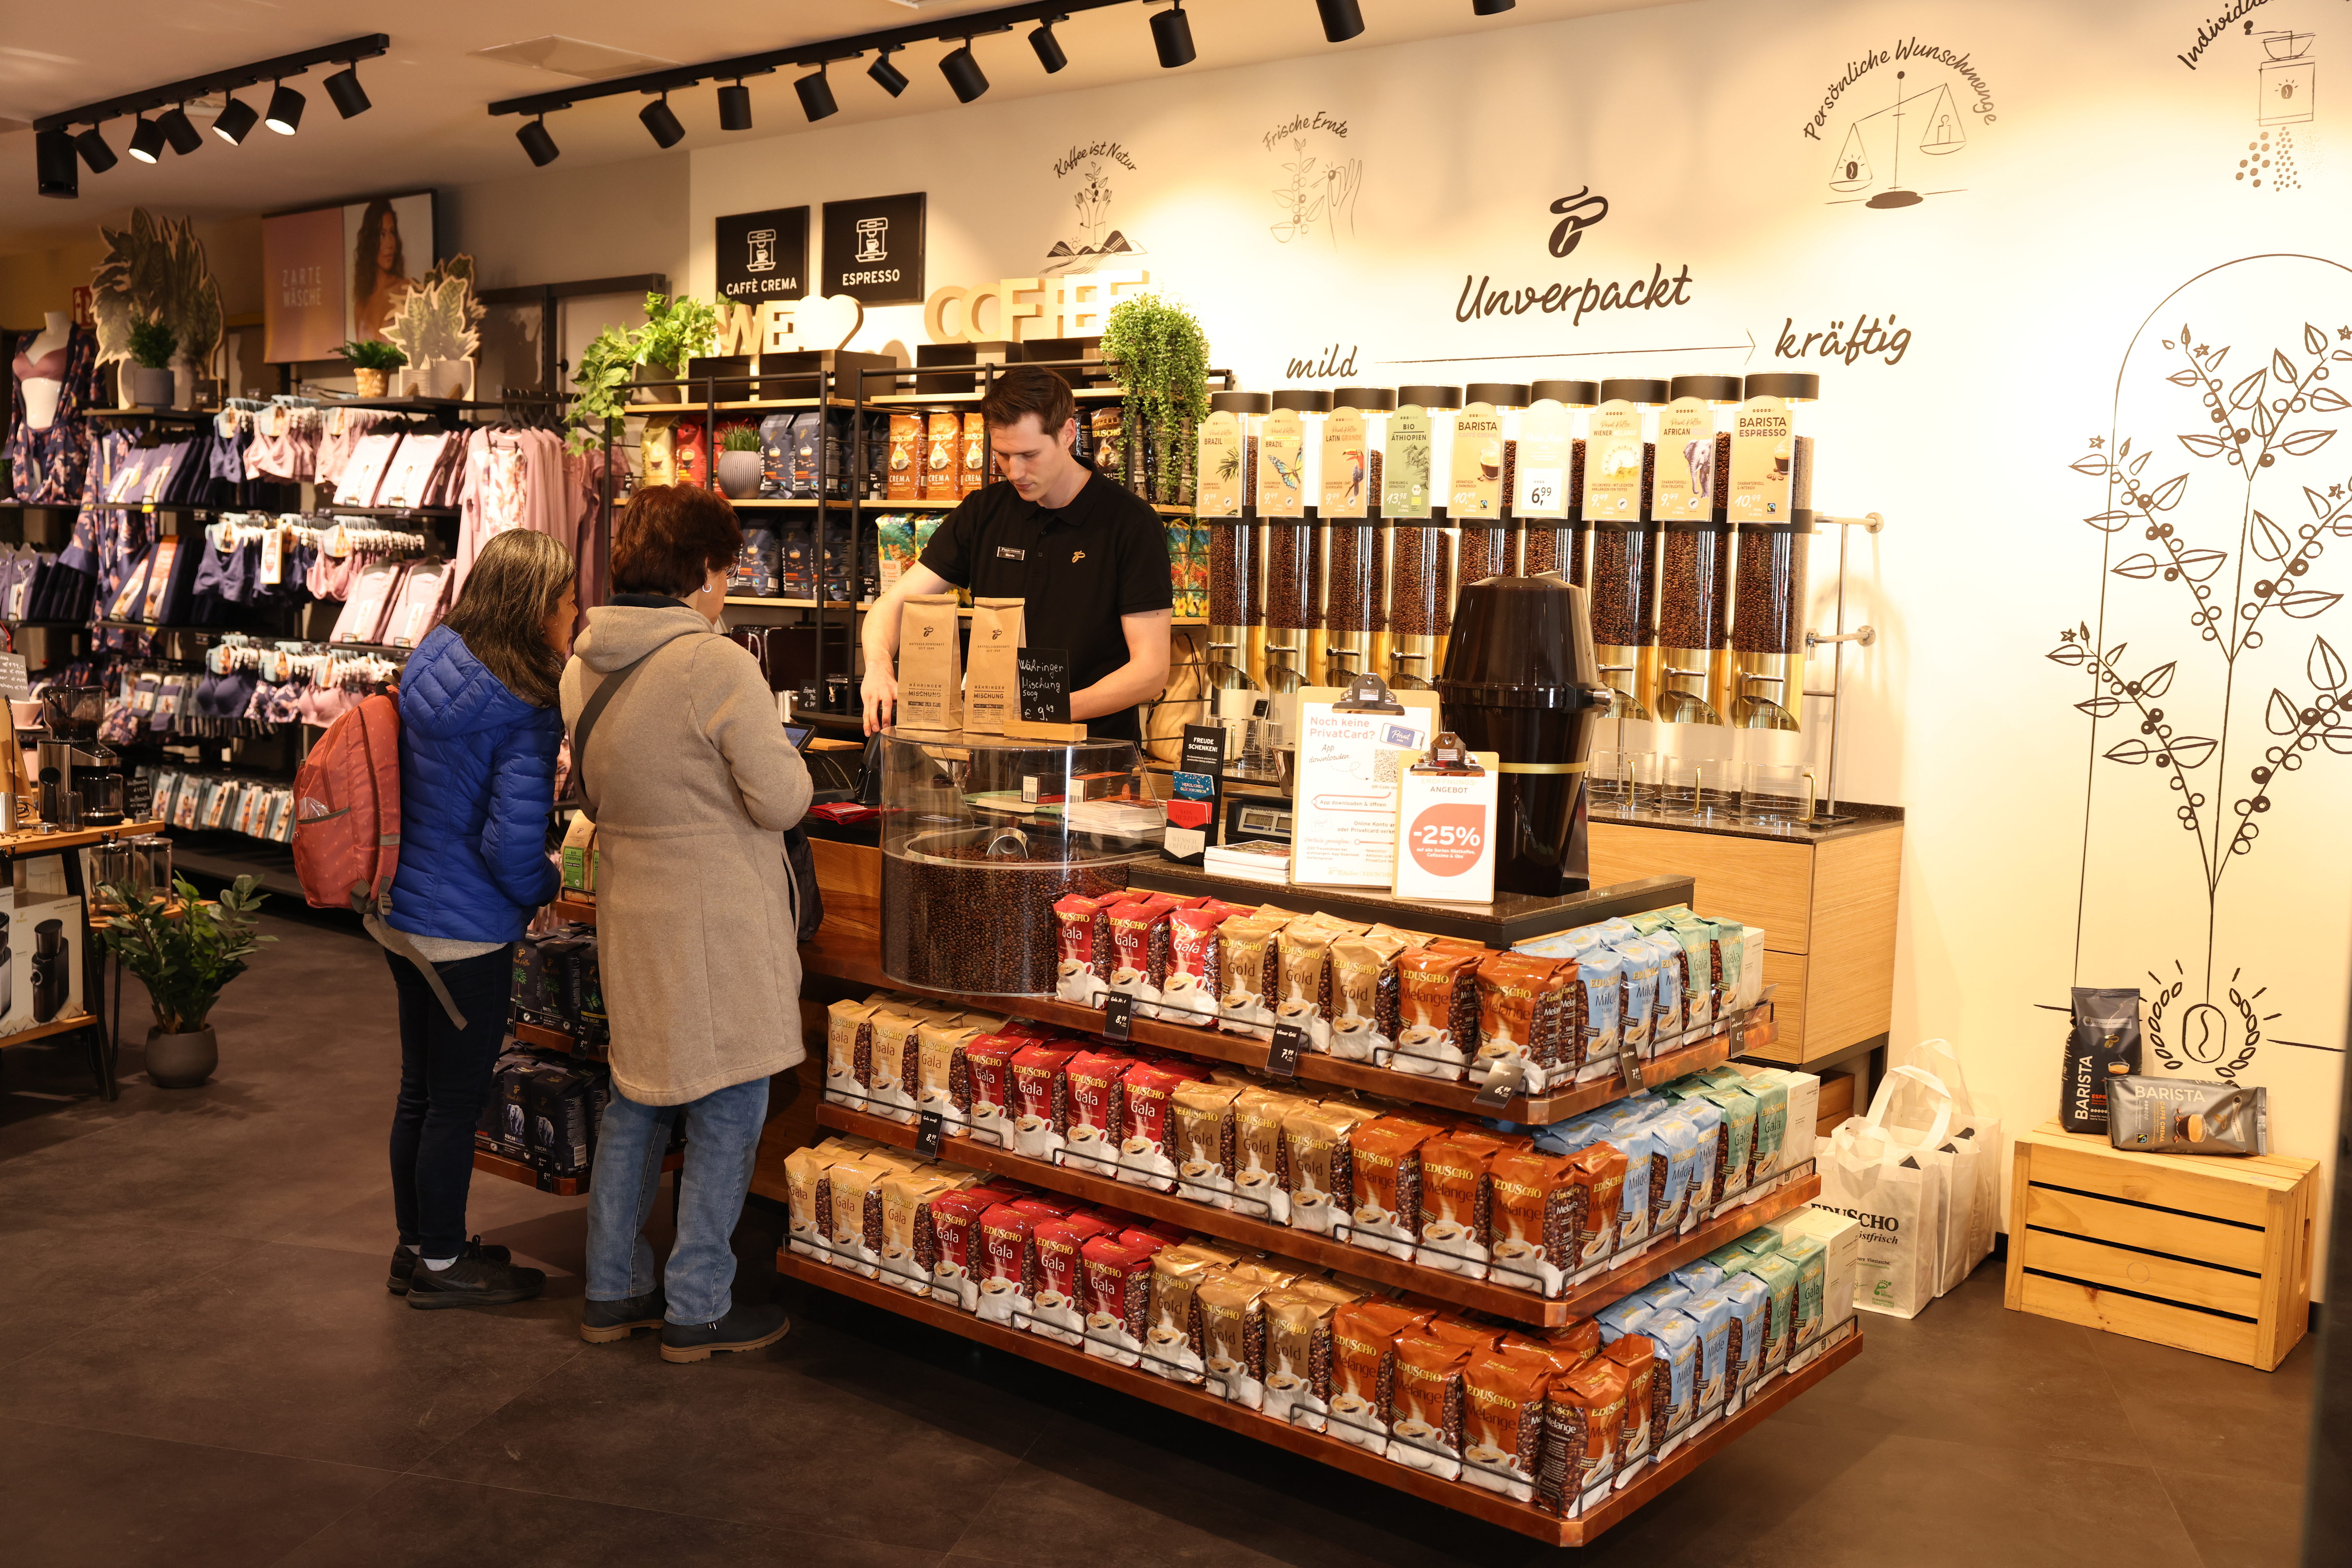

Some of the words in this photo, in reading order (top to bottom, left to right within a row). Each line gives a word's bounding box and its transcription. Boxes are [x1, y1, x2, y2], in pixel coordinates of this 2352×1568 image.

[1803, 49, 1890, 140] Persönliche
[1895, 36, 1997, 125] Wunschmenge
[1263, 114, 1310, 151] Frische
[1312, 111, 1348, 138] Ernte
[1053, 146, 1088, 178] Kaffee
[1089, 140, 1106, 156] ist
[1106, 143, 1137, 172] Natur
[283, 266, 321, 287] ZARTE
[842, 269, 900, 286] ESPRESSO
[726, 278, 758, 295] CAFFÈ
[761, 277, 797, 292] CREMA
[283, 287, 321, 307] WÄSCHE
[1455, 262, 1694, 327] Unverpackt
[1775, 314, 1912, 366] kräftig
[1286, 343, 1357, 380] mild
[1459, 422, 1497, 430] BARISTA
[1740, 418, 1786, 427] BARISTA
[1739, 429, 1786, 437] ESPRESSO
[1018, 659, 1064, 679] Währinger
[1022, 676, 1060, 693] Mischung
[1023, 690, 1038, 701] 500g
[1025, 709, 1032, 718] €
[1310, 716, 1337, 726] Noch
[1342, 718, 1370, 727] keine
[1310, 729, 1375, 739] PrivatCard?
[1391, 730, 1412, 740] Privat
[1188, 744, 1218, 752] SCHENKEN!
[1321, 744, 1334, 753] App
[1308, 753, 1350, 763] downloaden
[1172, 836, 1196, 844] WUNSCH
[1413, 825, 1481, 846] -25%
[1169, 843, 1199, 851] ERFÜLLER
[1110, 918, 1147, 930] EDUSCHO
[1115, 933, 1138, 948] Gala
[1278, 944, 1320, 960] EDUSCHO
[1283, 961, 1302, 969] Wiener
[1285, 969, 1312, 985] Gold
[1403, 969, 1450, 984] EDUSCHO
[1401, 988, 1448, 1007] Melange
[876, 1041, 895, 1056] Gala
[2075, 1055, 2093, 1120] BARISTA
[2135, 1086, 2206, 1102] BARISTA
[831, 1180, 862, 1197] EDUSCHO
[1801, 1266, 1821, 1284] EDUSCHO
[1805, 1283, 1819, 1300] Gala
[1708, 1338, 1725, 1358] Milde
[1396, 1359, 1442, 1383] EDUSCHO
[1394, 1377, 1442, 1404] Melange
